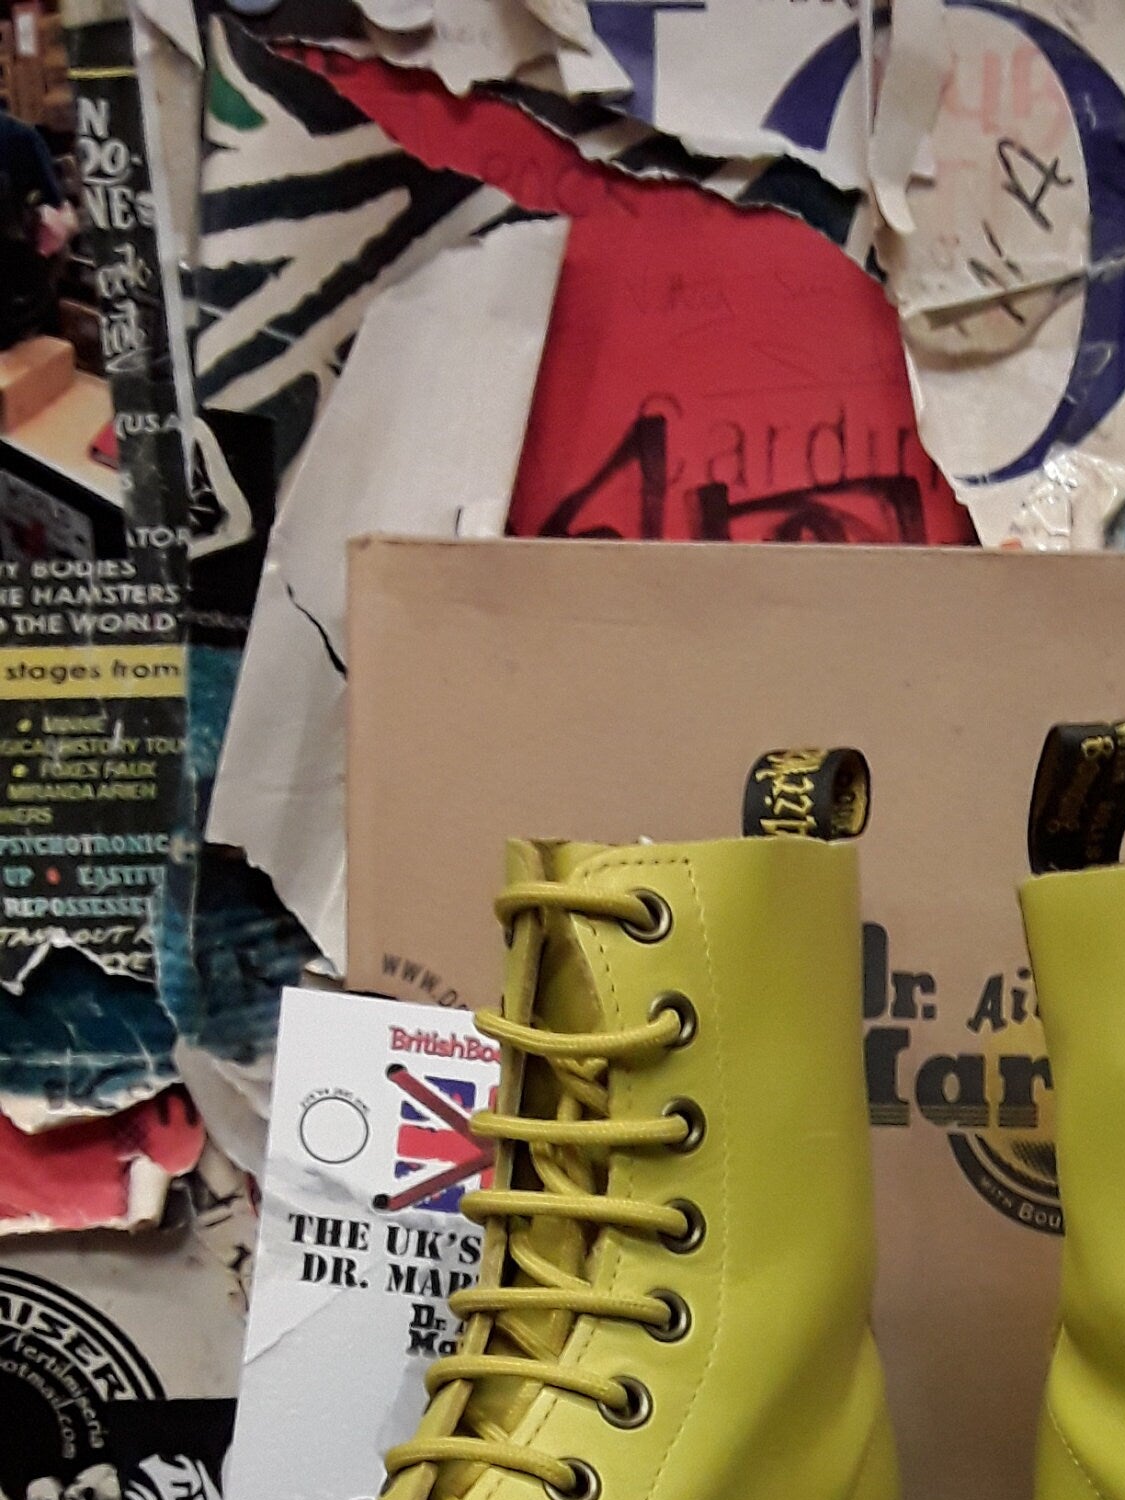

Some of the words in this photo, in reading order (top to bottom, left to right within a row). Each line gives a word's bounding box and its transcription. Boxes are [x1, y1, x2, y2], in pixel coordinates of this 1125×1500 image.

[32, 583, 181, 606] HAMSTERS
[68, 611, 177, 634] WORLD
[6, 661, 101, 684] stages
[112, 659, 179, 680] from
[288, 1213, 370, 1251] THE
[386, 1225, 482, 1265] UK'S
[300, 1252, 369, 1289] DR.
[384, 1263, 478, 1299] MAR
